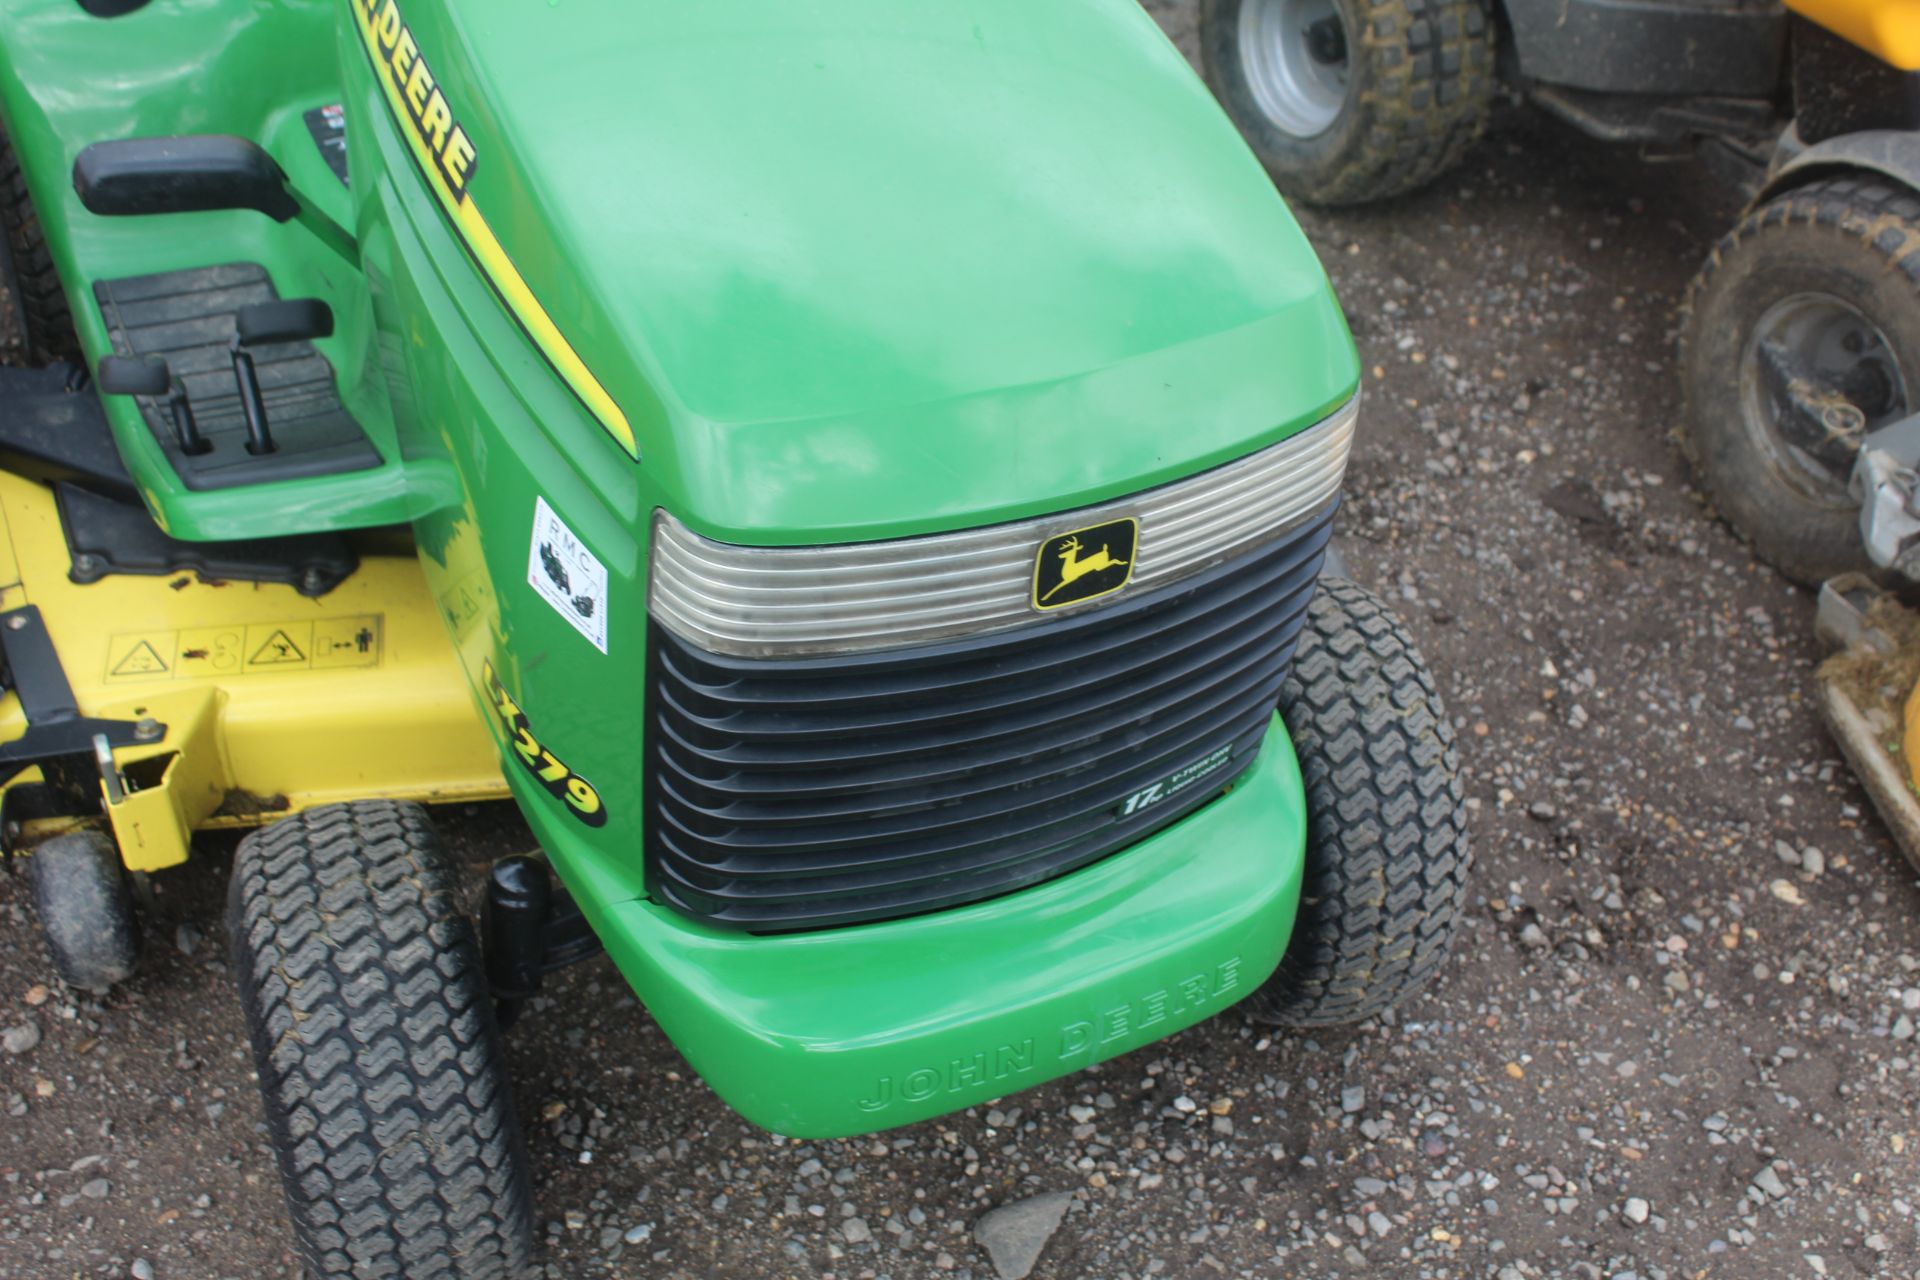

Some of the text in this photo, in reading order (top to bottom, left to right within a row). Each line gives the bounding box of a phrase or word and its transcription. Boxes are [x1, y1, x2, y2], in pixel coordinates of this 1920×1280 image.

[379, 0, 477, 192] DEERE
[857, 955, 1242, 1113] JOHN DEERE
